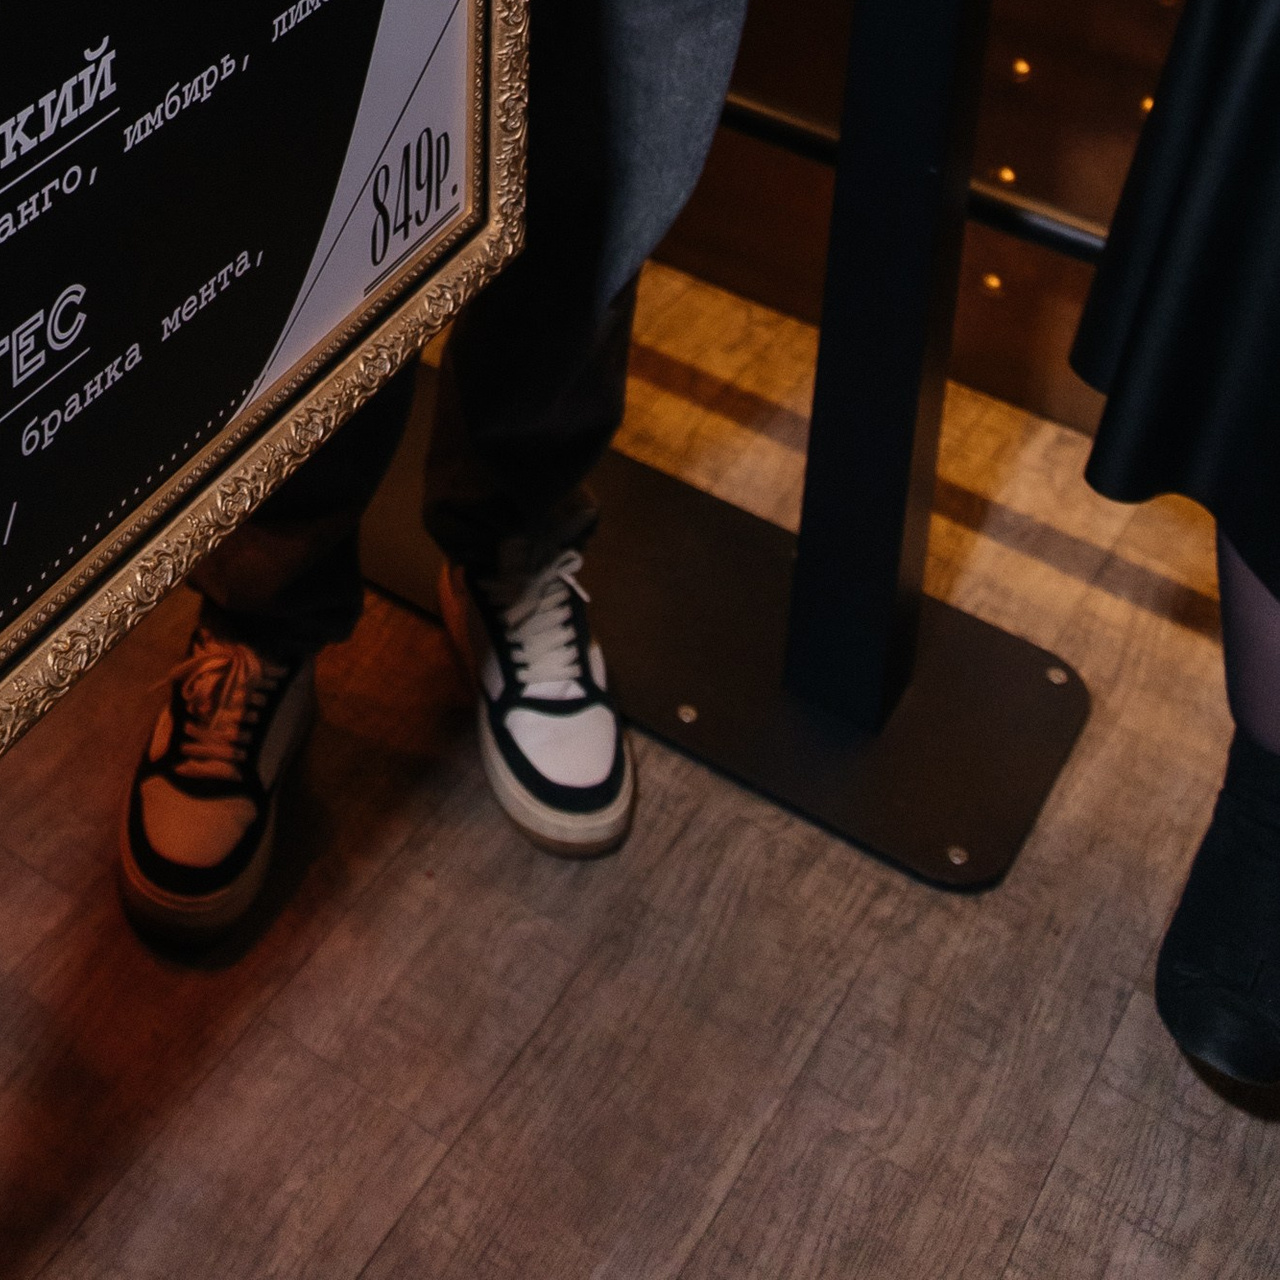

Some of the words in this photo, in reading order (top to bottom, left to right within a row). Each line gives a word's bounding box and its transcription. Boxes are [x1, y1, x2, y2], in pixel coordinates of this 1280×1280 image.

[123, 53, 250, 153] имбирь,
[21, 342, 144, 457] бранка
[161, 249, 264, 342] мента,
